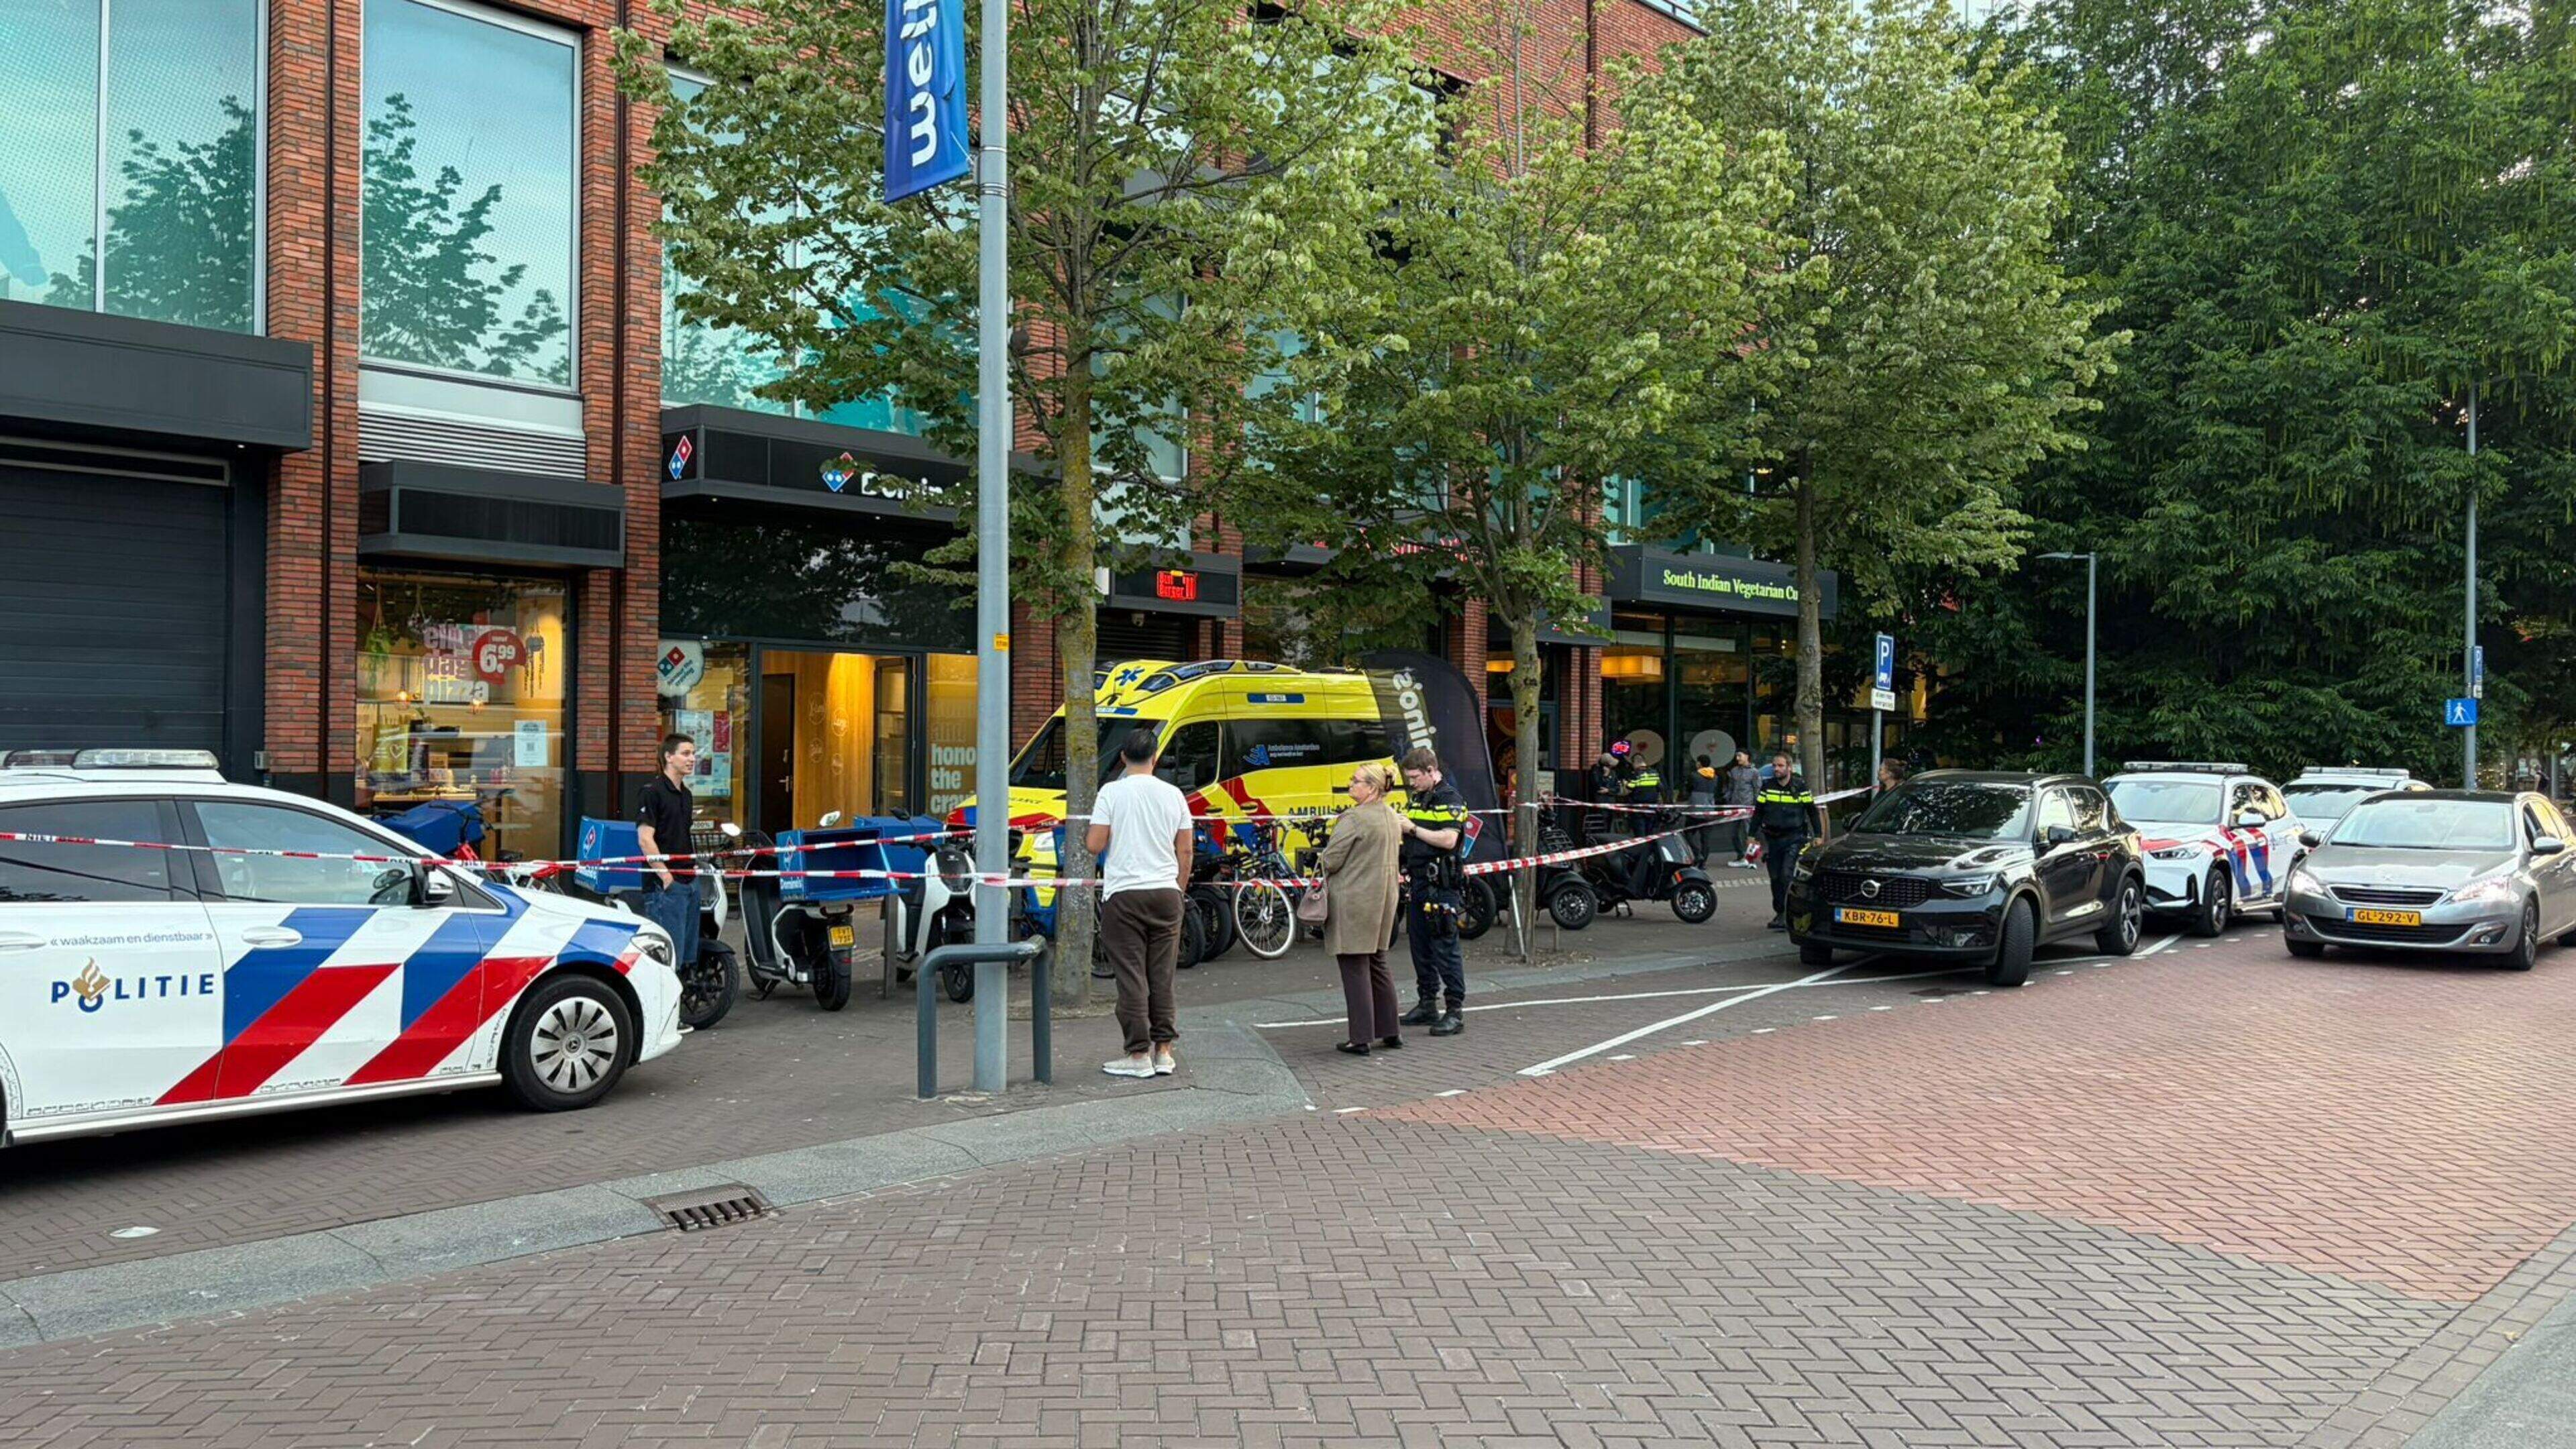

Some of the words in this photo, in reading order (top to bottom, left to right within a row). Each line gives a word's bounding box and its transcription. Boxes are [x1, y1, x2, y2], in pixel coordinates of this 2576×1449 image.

[1664, 570, 1695, 588] South
[1697, 574, 1731, 592] Indian
[1733, 578, 1784, 598] Vegetarian
[1786, 585, 1799, 600] Cu
[1880, 641, 1890, 666] P
[423, 680, 489, 704] pizza
[931, 743, 977, 765] hono
[930, 767, 962, 790] the
[1844, 910, 1894, 925] KBR-76-L
[60, 934, 125, 946] waakzaam
[127, 932, 142, 943] en
[143, 932, 203, 943] dienstbaar
[51, 973, 215, 1014] POLITIE
